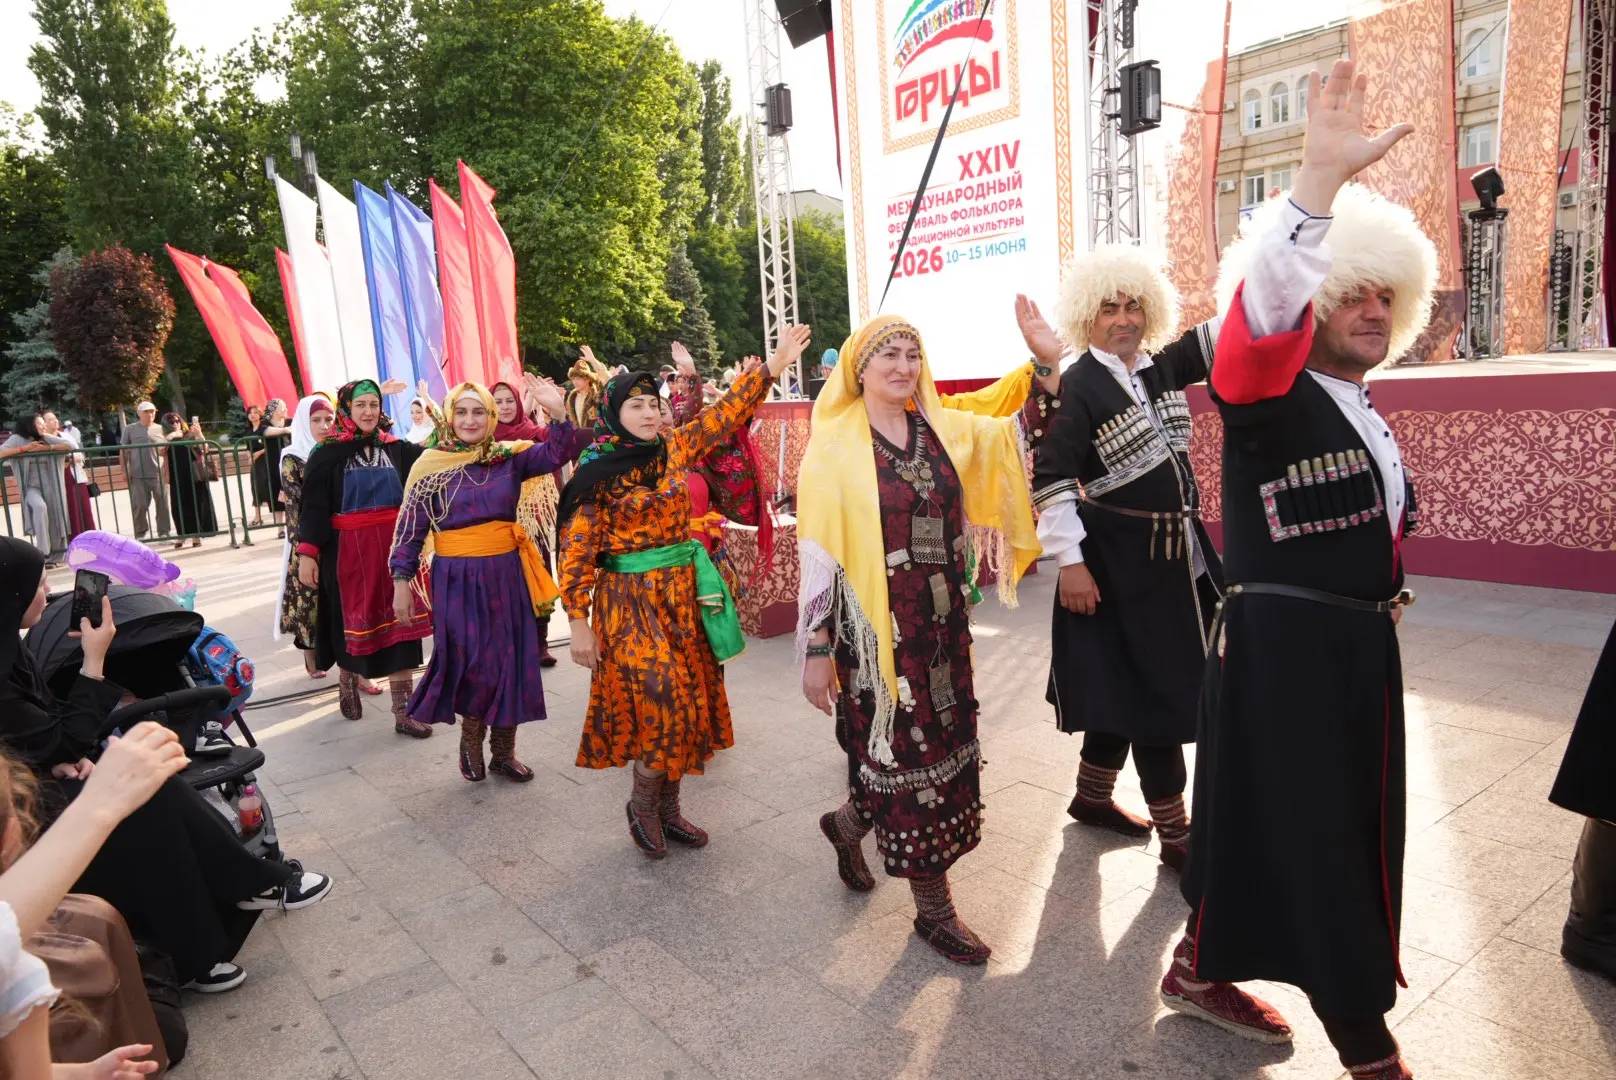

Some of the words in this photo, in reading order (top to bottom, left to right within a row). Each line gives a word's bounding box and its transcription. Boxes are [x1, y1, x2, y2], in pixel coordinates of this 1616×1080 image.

[957, 139, 1020, 182] XXIV
[888, 214, 948, 235] ФЕСИВАЛЬ
[950, 196, 1023, 222] ФОЛЬКЛОРА
[889, 241, 895, 250] И
[896, 224, 971, 249] ТАДИЦИОННОЙ
[973, 215, 1025, 234] КУЛЬТУРЫ
[985, 238, 1026, 257] ИЮНЯ
